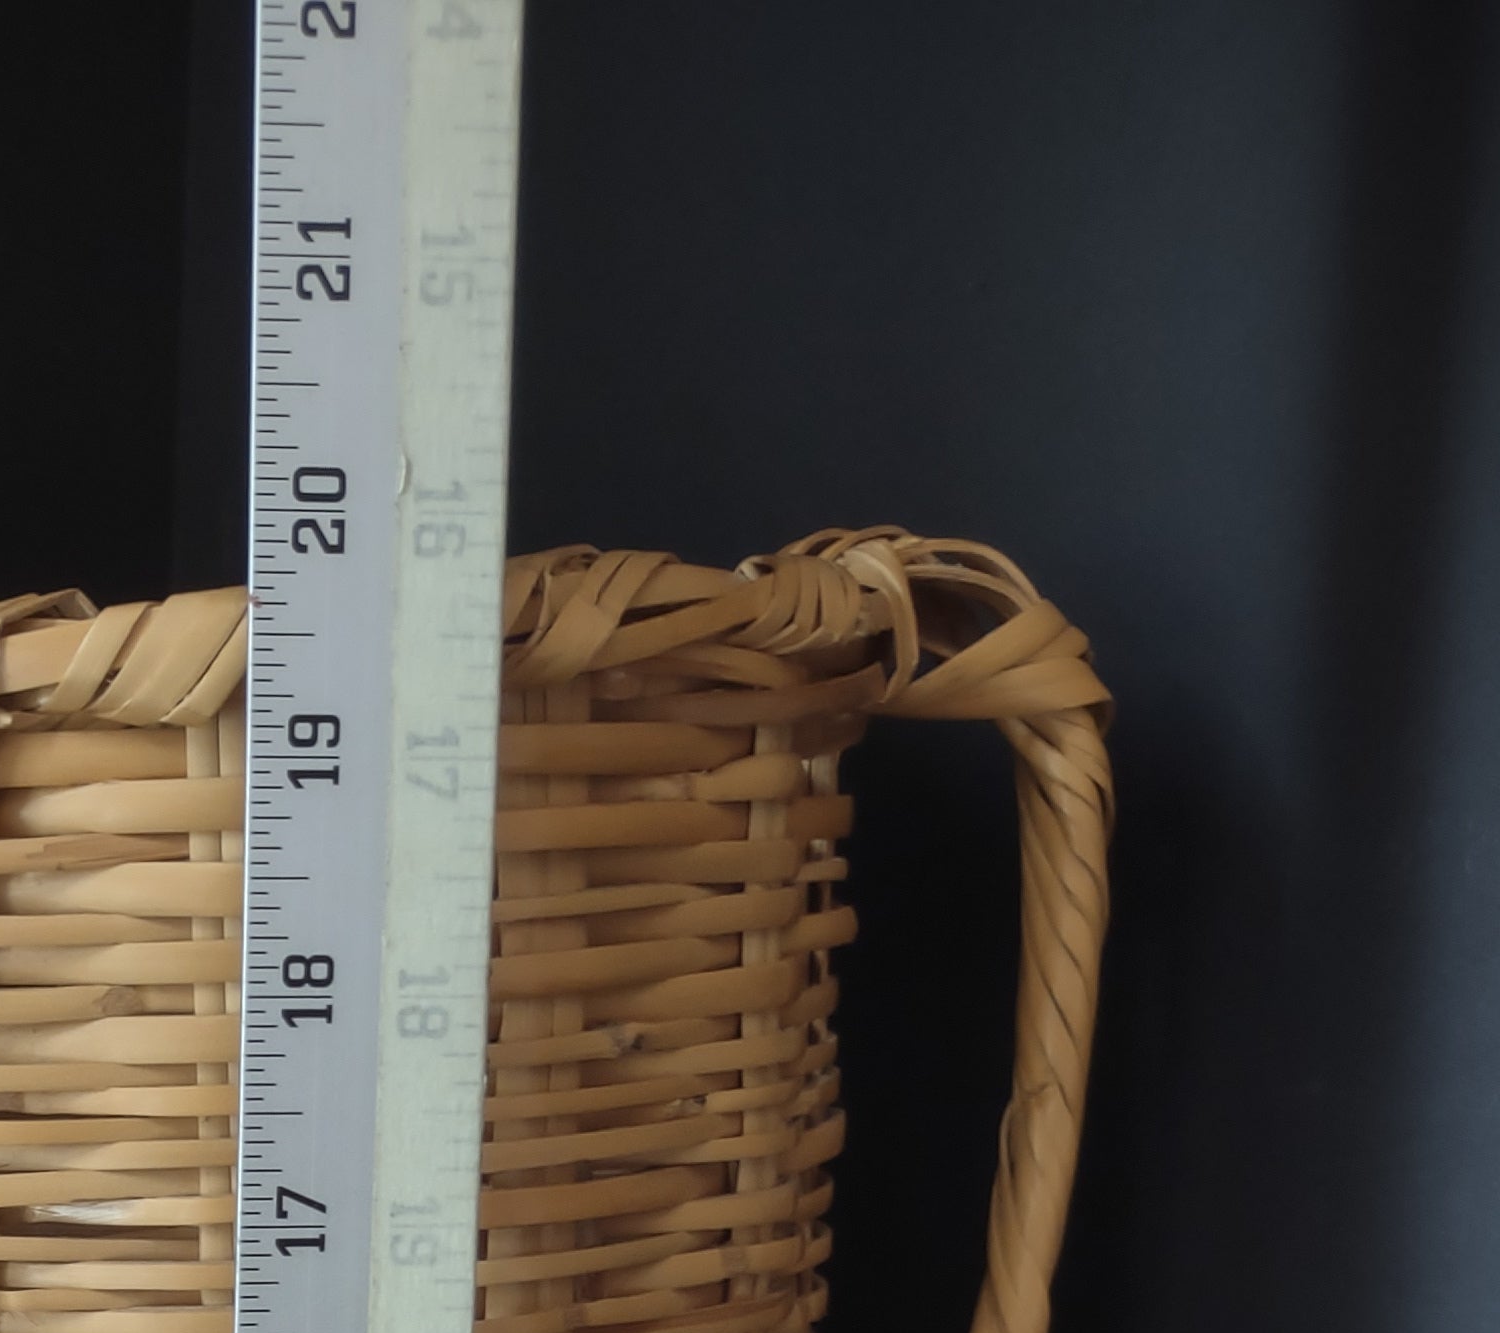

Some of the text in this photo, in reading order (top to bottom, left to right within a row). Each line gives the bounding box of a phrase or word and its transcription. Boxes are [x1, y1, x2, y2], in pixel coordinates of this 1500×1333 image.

[300, 0, 356, 39] 2
[426, 2, 482, 41] 4
[297, 217, 352, 301] 21
[420, 223, 475, 306] 15
[291, 466, 346, 555] 20
[413, 479, 466, 558] 16
[287, 714, 341, 786] 19
[407, 726, 460, 800] 17
[281, 954, 334, 1027] 18
[398, 969, 449, 1040] 18
[276, 1186, 327, 1256] 17
[390, 1199, 440, 1269] 19
